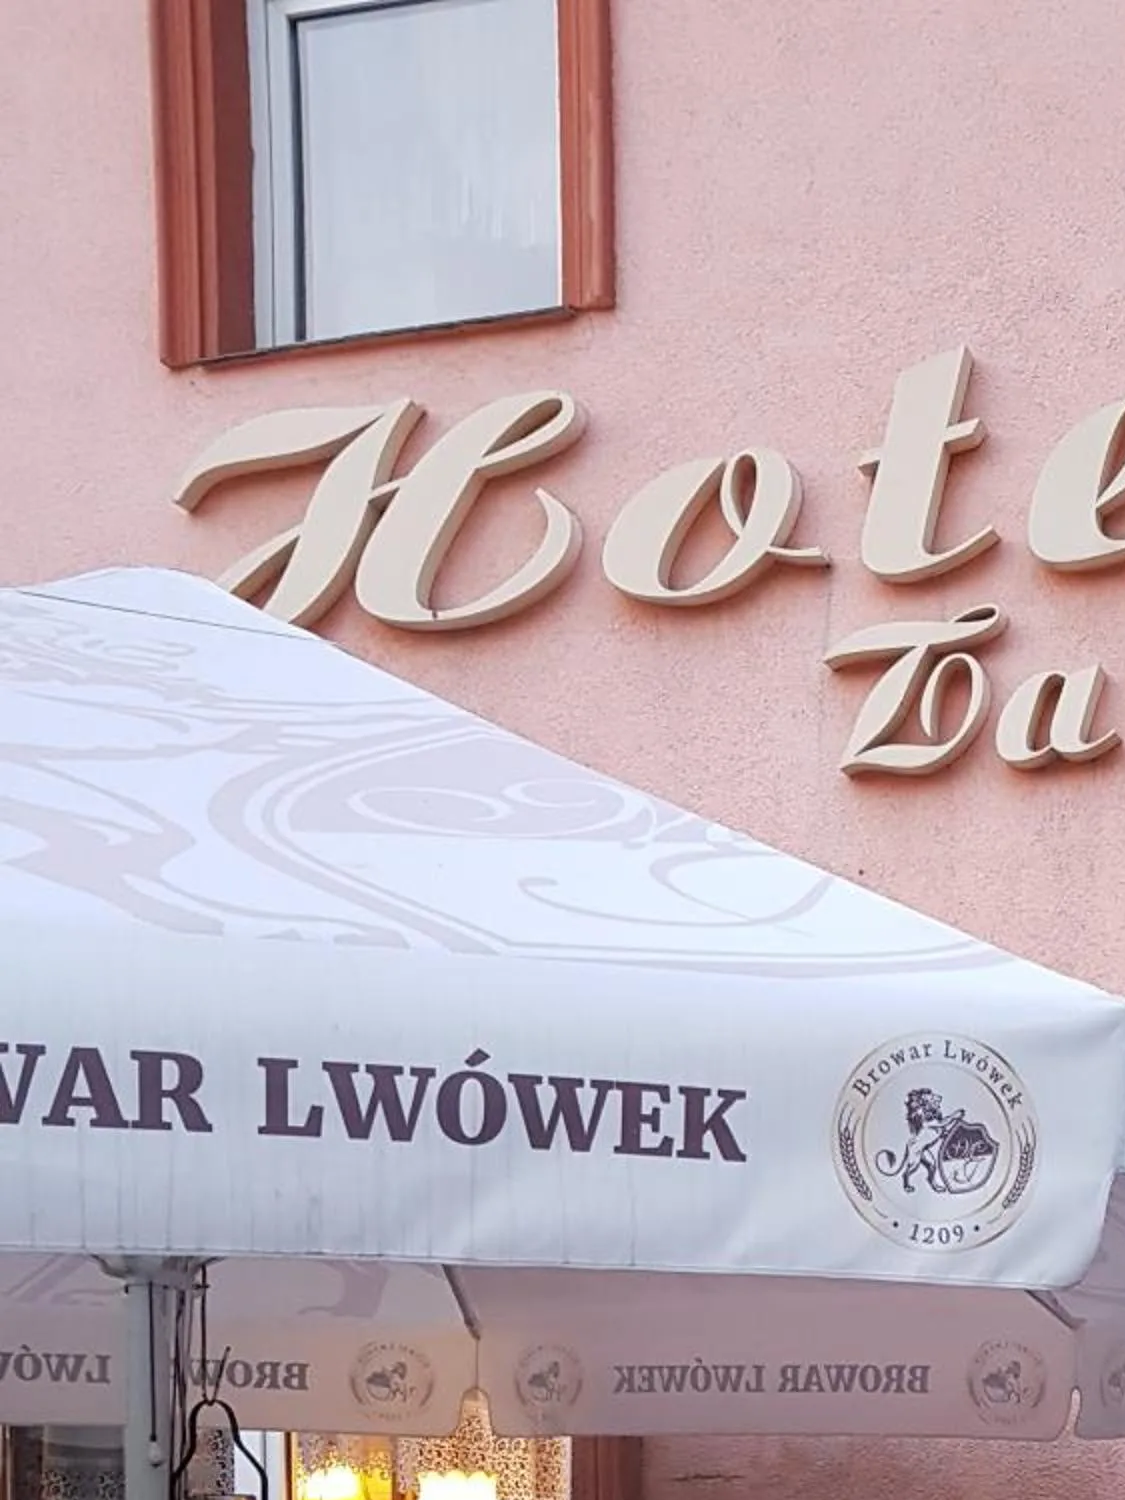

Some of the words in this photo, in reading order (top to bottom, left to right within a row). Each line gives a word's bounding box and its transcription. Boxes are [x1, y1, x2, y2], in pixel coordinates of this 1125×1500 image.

[257, 1047, 748, 1163] LWÓWEK
[852, 1041, 933, 1098] Browar
[943, 1039, 1025, 1110] Lwówek
[908, 1222, 966, 1245] 1209
